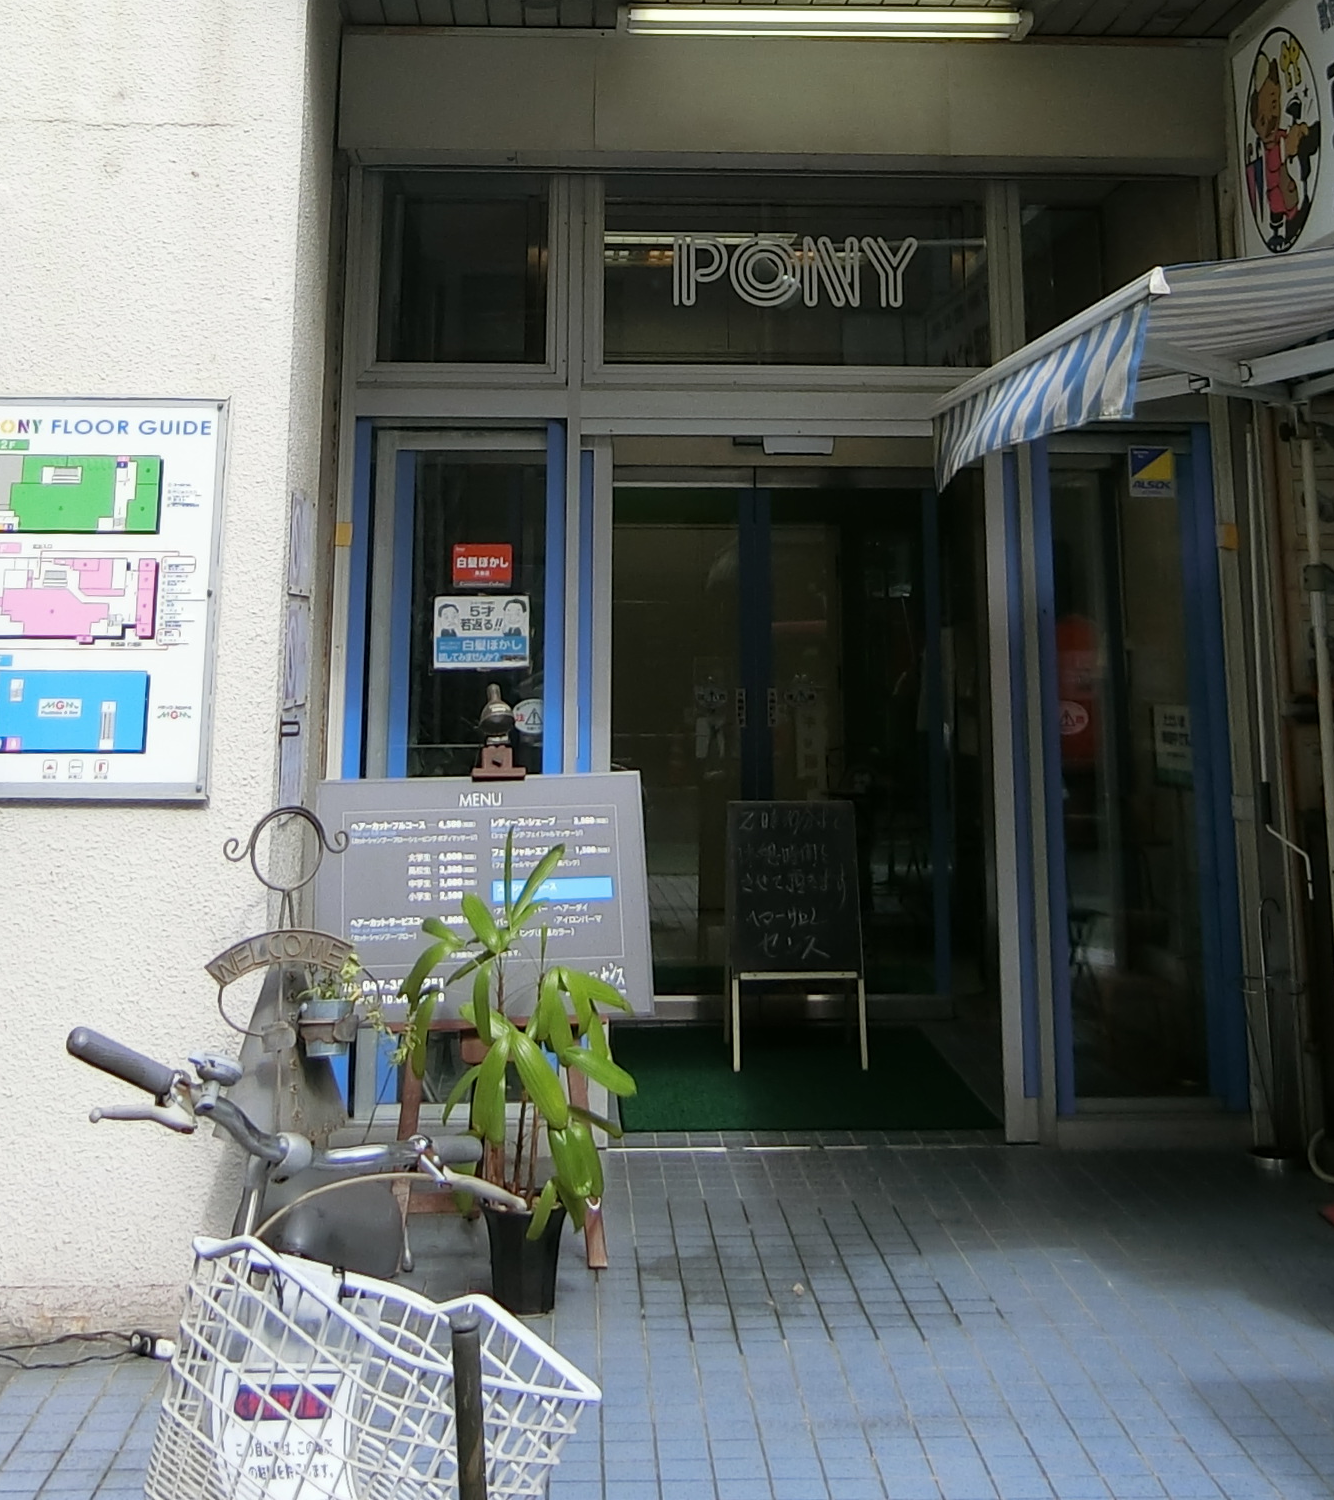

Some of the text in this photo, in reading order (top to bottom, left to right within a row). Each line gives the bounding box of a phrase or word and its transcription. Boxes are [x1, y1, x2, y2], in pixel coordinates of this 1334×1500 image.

[673, 235, 919, 308] PONY
[51, 419, 129, 435] FLOOR
[138, 420, 212, 435] GUIDE
[0, 440, 16, 450] 2F
[1132, 480, 1171, 490] ALSOK
[469, 605, 495, 618] 5才
[458, 792, 502, 807] MENU
[210, 934, 347, 984] WELCOME
